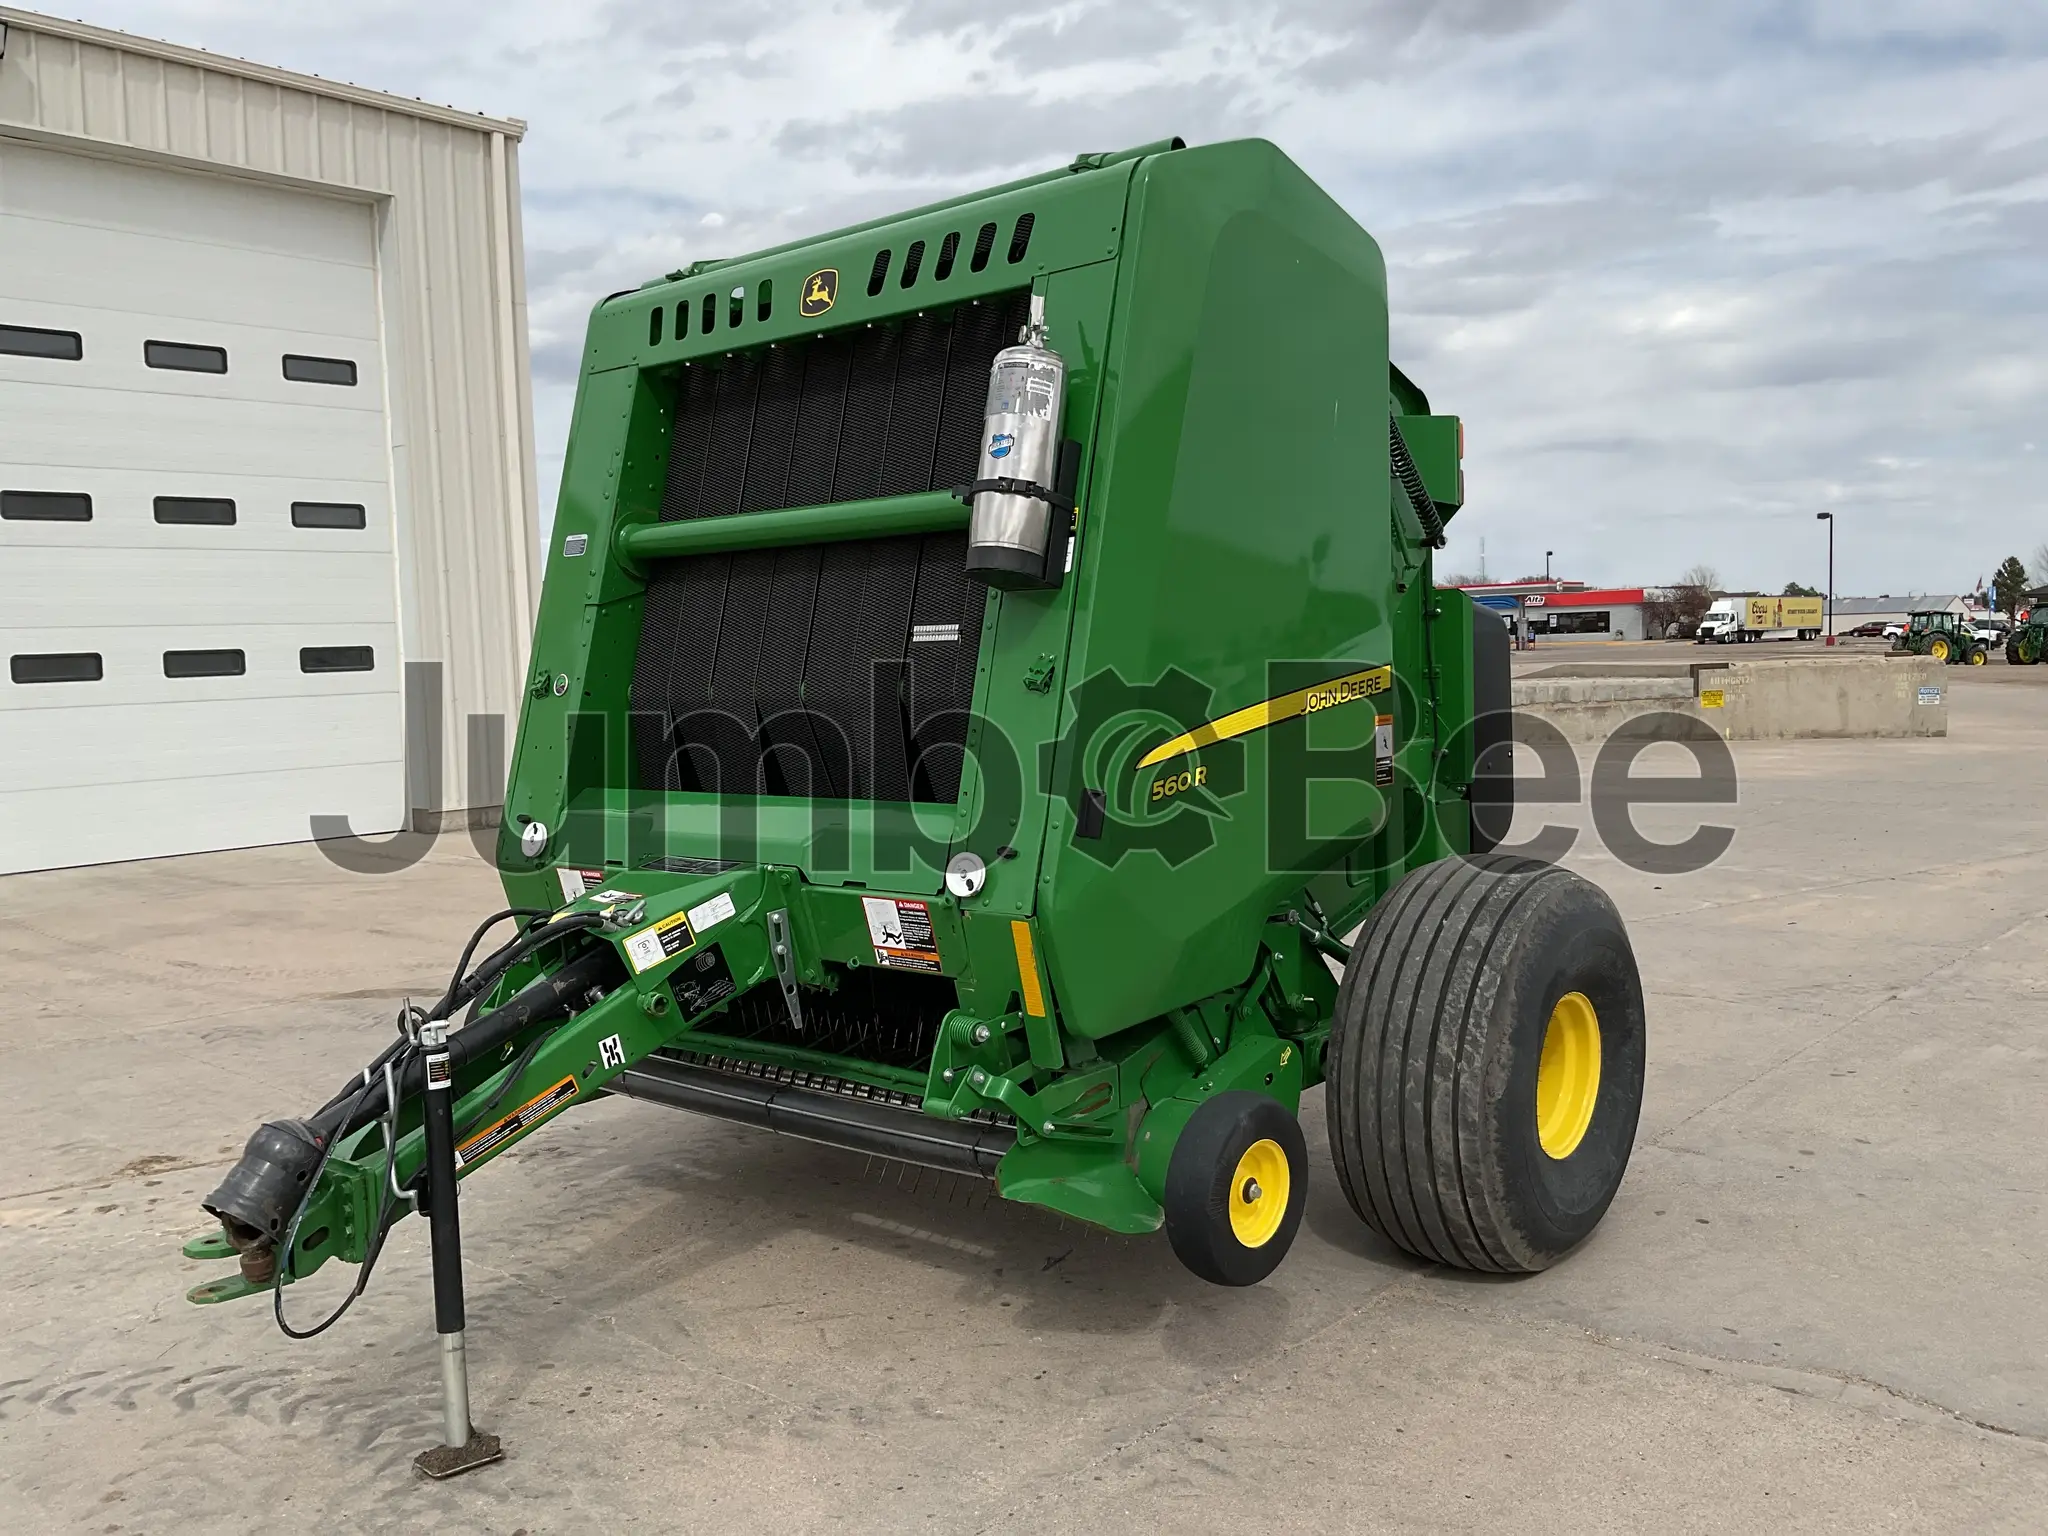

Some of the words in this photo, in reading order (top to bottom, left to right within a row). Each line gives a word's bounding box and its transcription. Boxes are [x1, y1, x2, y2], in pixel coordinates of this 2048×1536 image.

[1300, 687, 1337, 714] JOHN
[1340, 675, 1382, 700] DEERE
[903, 902, 925, 910] DANGER
[661, 916, 682, 929] CAUTION
